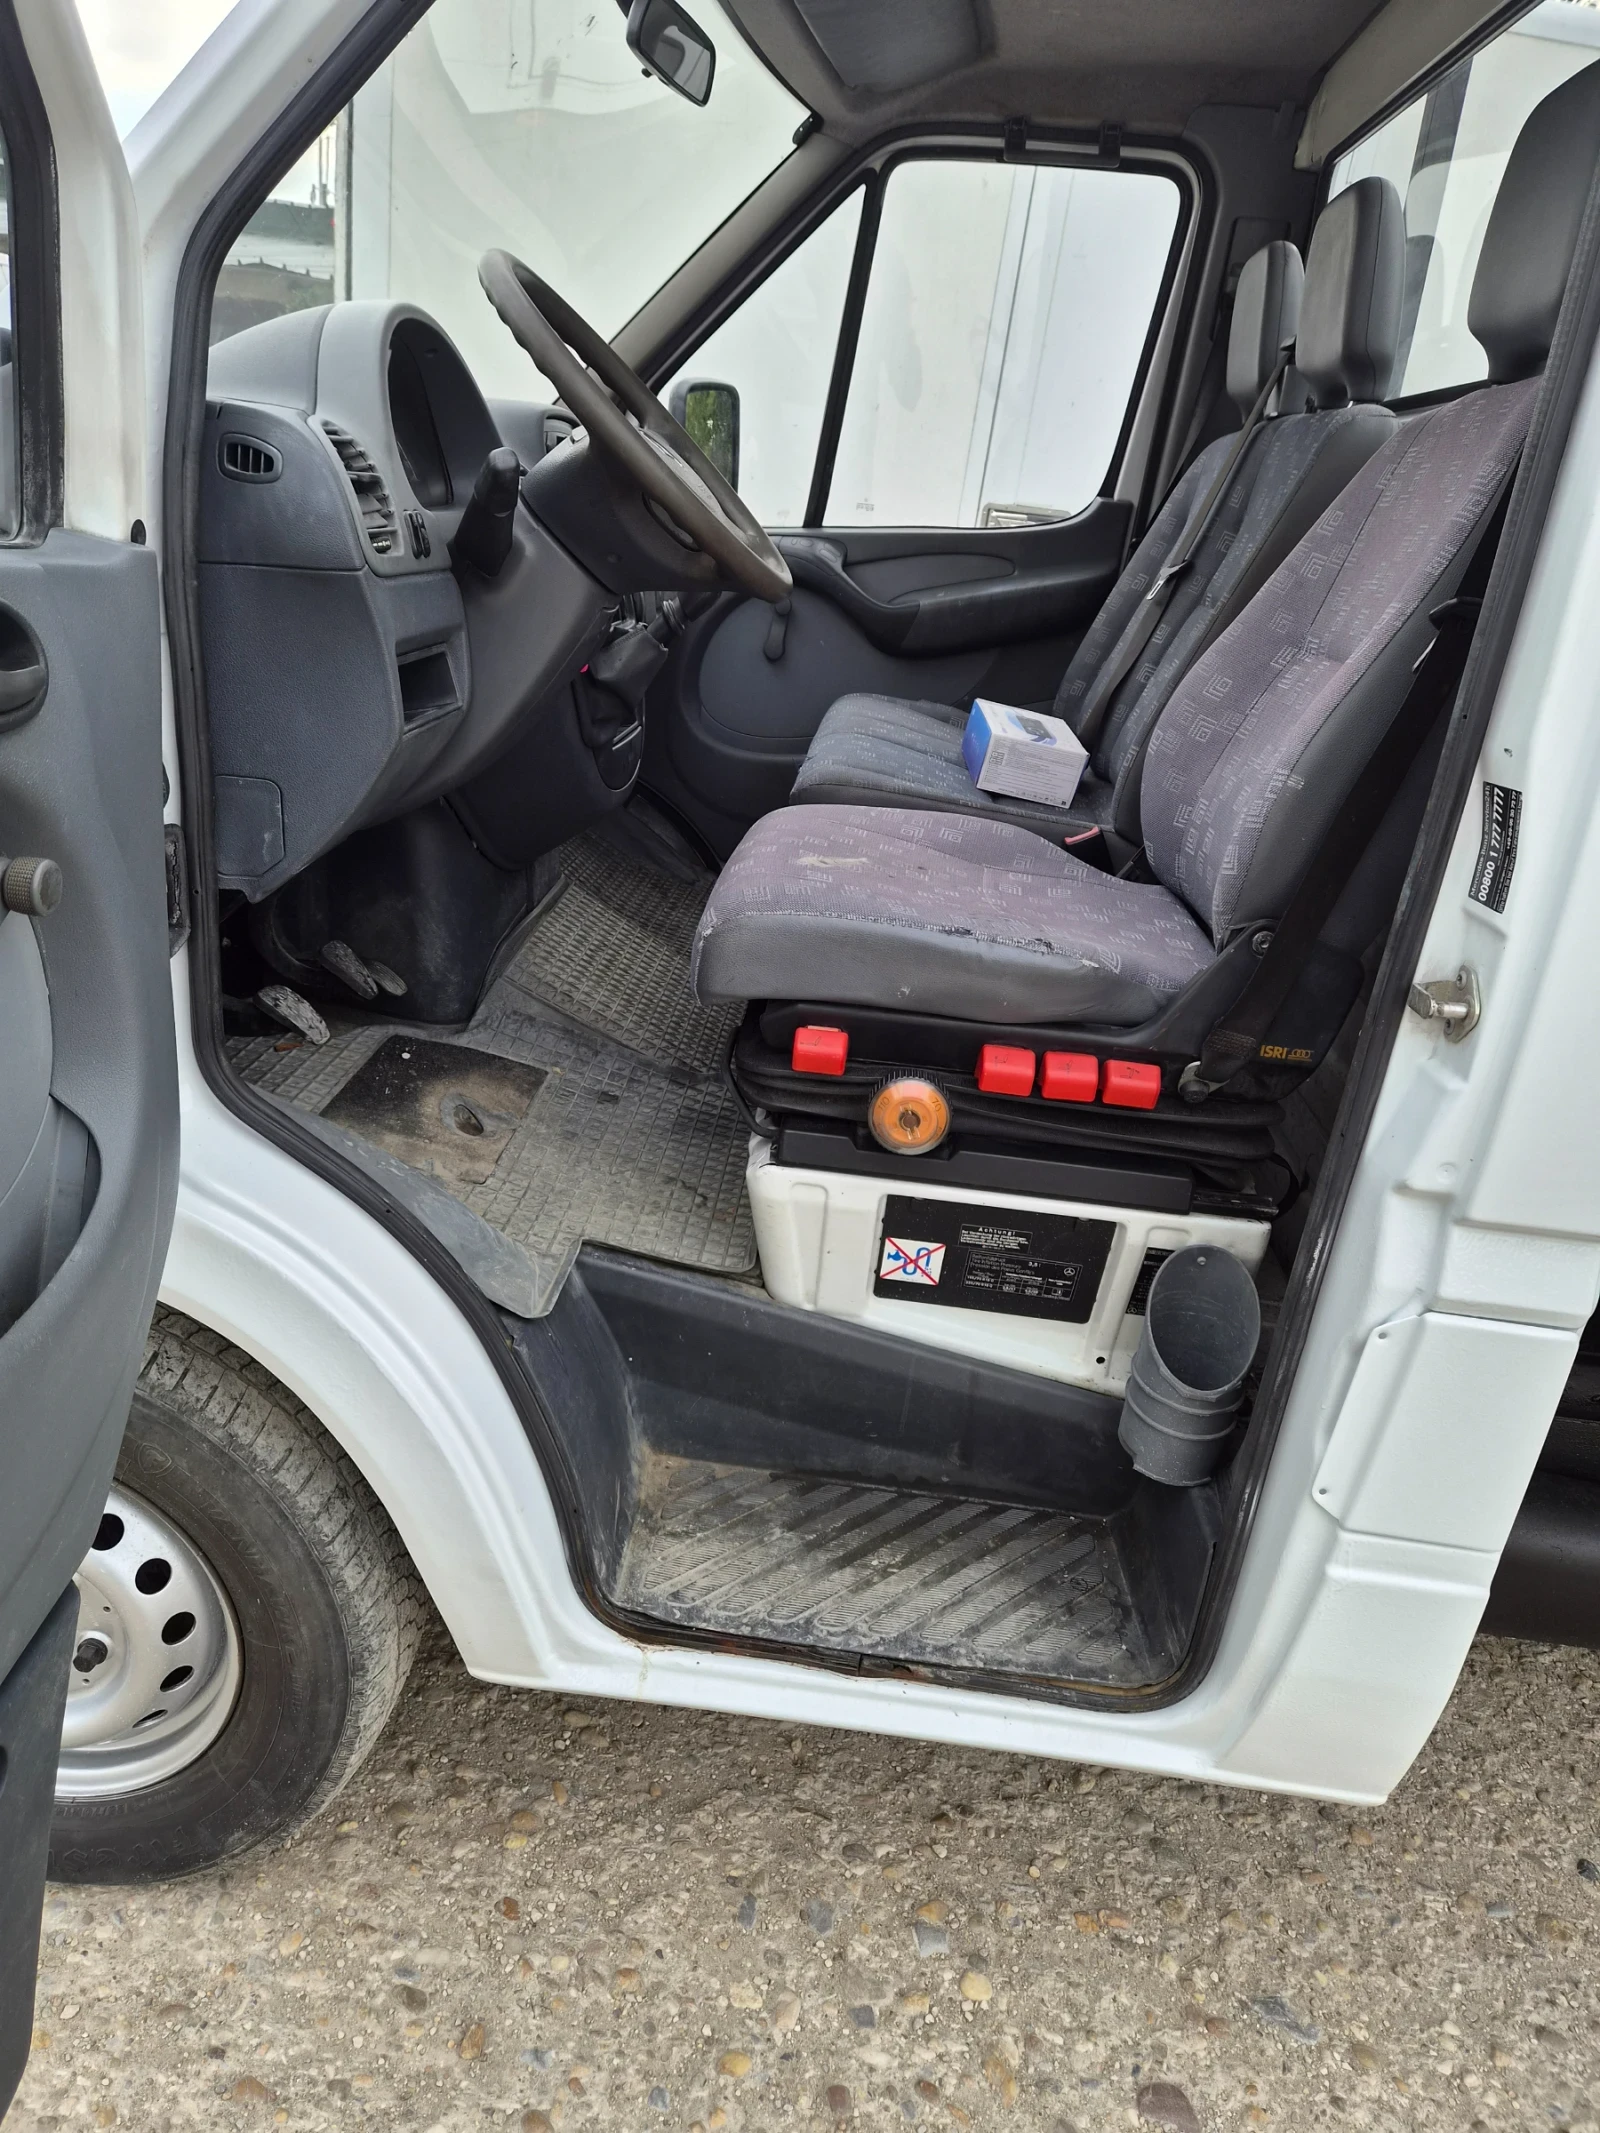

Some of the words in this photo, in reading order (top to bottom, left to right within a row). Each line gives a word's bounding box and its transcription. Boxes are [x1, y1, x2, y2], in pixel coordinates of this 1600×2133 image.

[1493, 787, 1504, 821] 7777
[1491, 822, 1500, 849] 777
[1478, 861, 1495, 901] 00800
[1259, 1044, 1288, 1060] ISRI
[878, 1096, 890, 1111] 110
[931, 1097, 942, 1112] 70
[978, 1227, 1015, 1236] Achtung!
